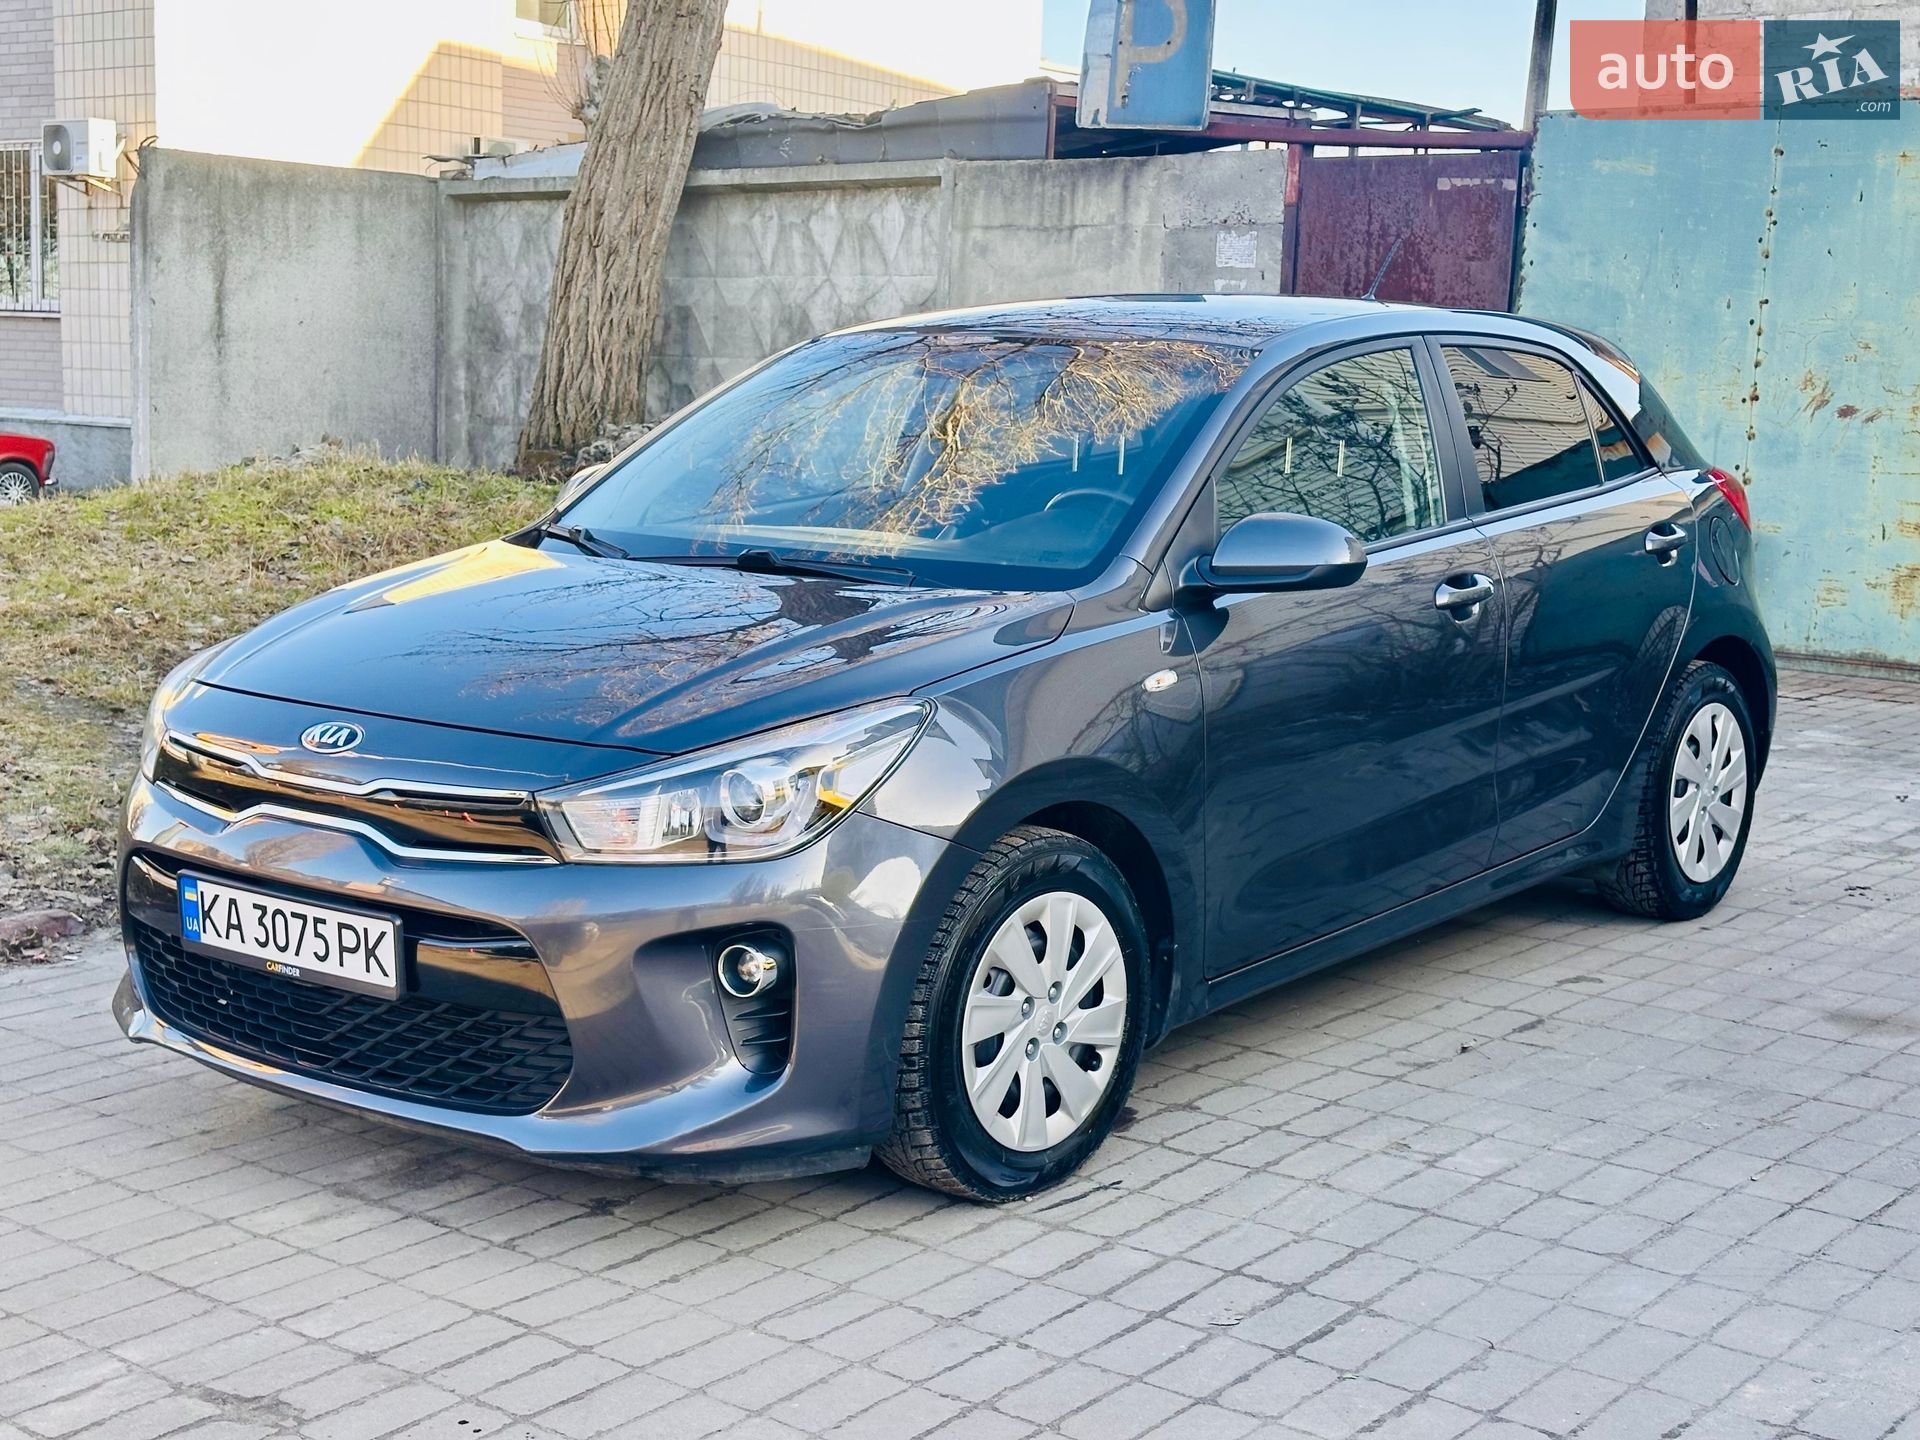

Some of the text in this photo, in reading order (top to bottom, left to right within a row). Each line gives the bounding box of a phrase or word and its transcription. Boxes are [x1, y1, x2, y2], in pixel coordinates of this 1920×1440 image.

[1114, 0, 1188, 108] P
[306, 725, 351, 746] KIA
[186, 916, 200, 933] UA
[200, 890, 390, 978] KA 3075 PK
